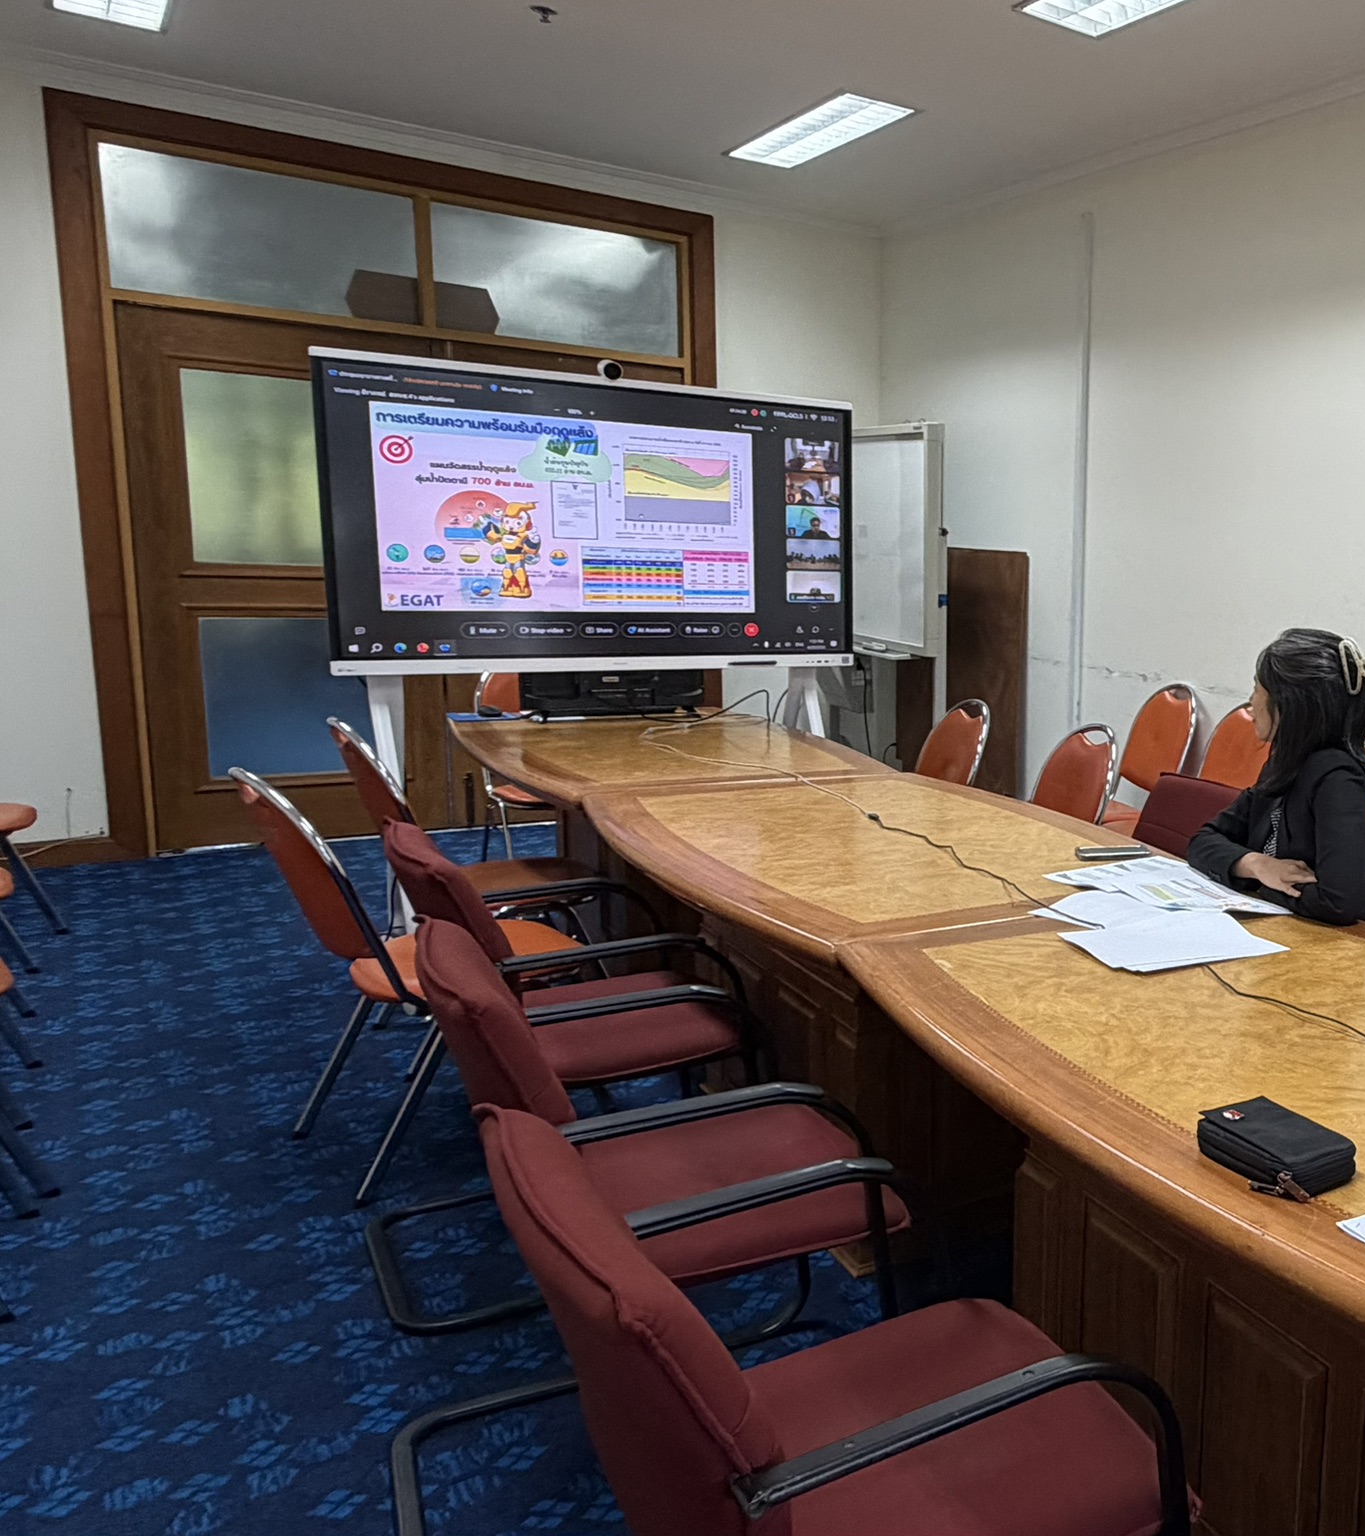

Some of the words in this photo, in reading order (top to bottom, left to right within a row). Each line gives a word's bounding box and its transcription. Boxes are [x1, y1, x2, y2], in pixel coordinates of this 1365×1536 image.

[472, 477, 491, 486] 700
[400, 594, 444, 607] EGAT
[479, 626, 497, 634] Mute
[530, 626, 547, 635] Stop
[596, 626, 613, 634] Share
[645, 626, 671, 634] Assistant
